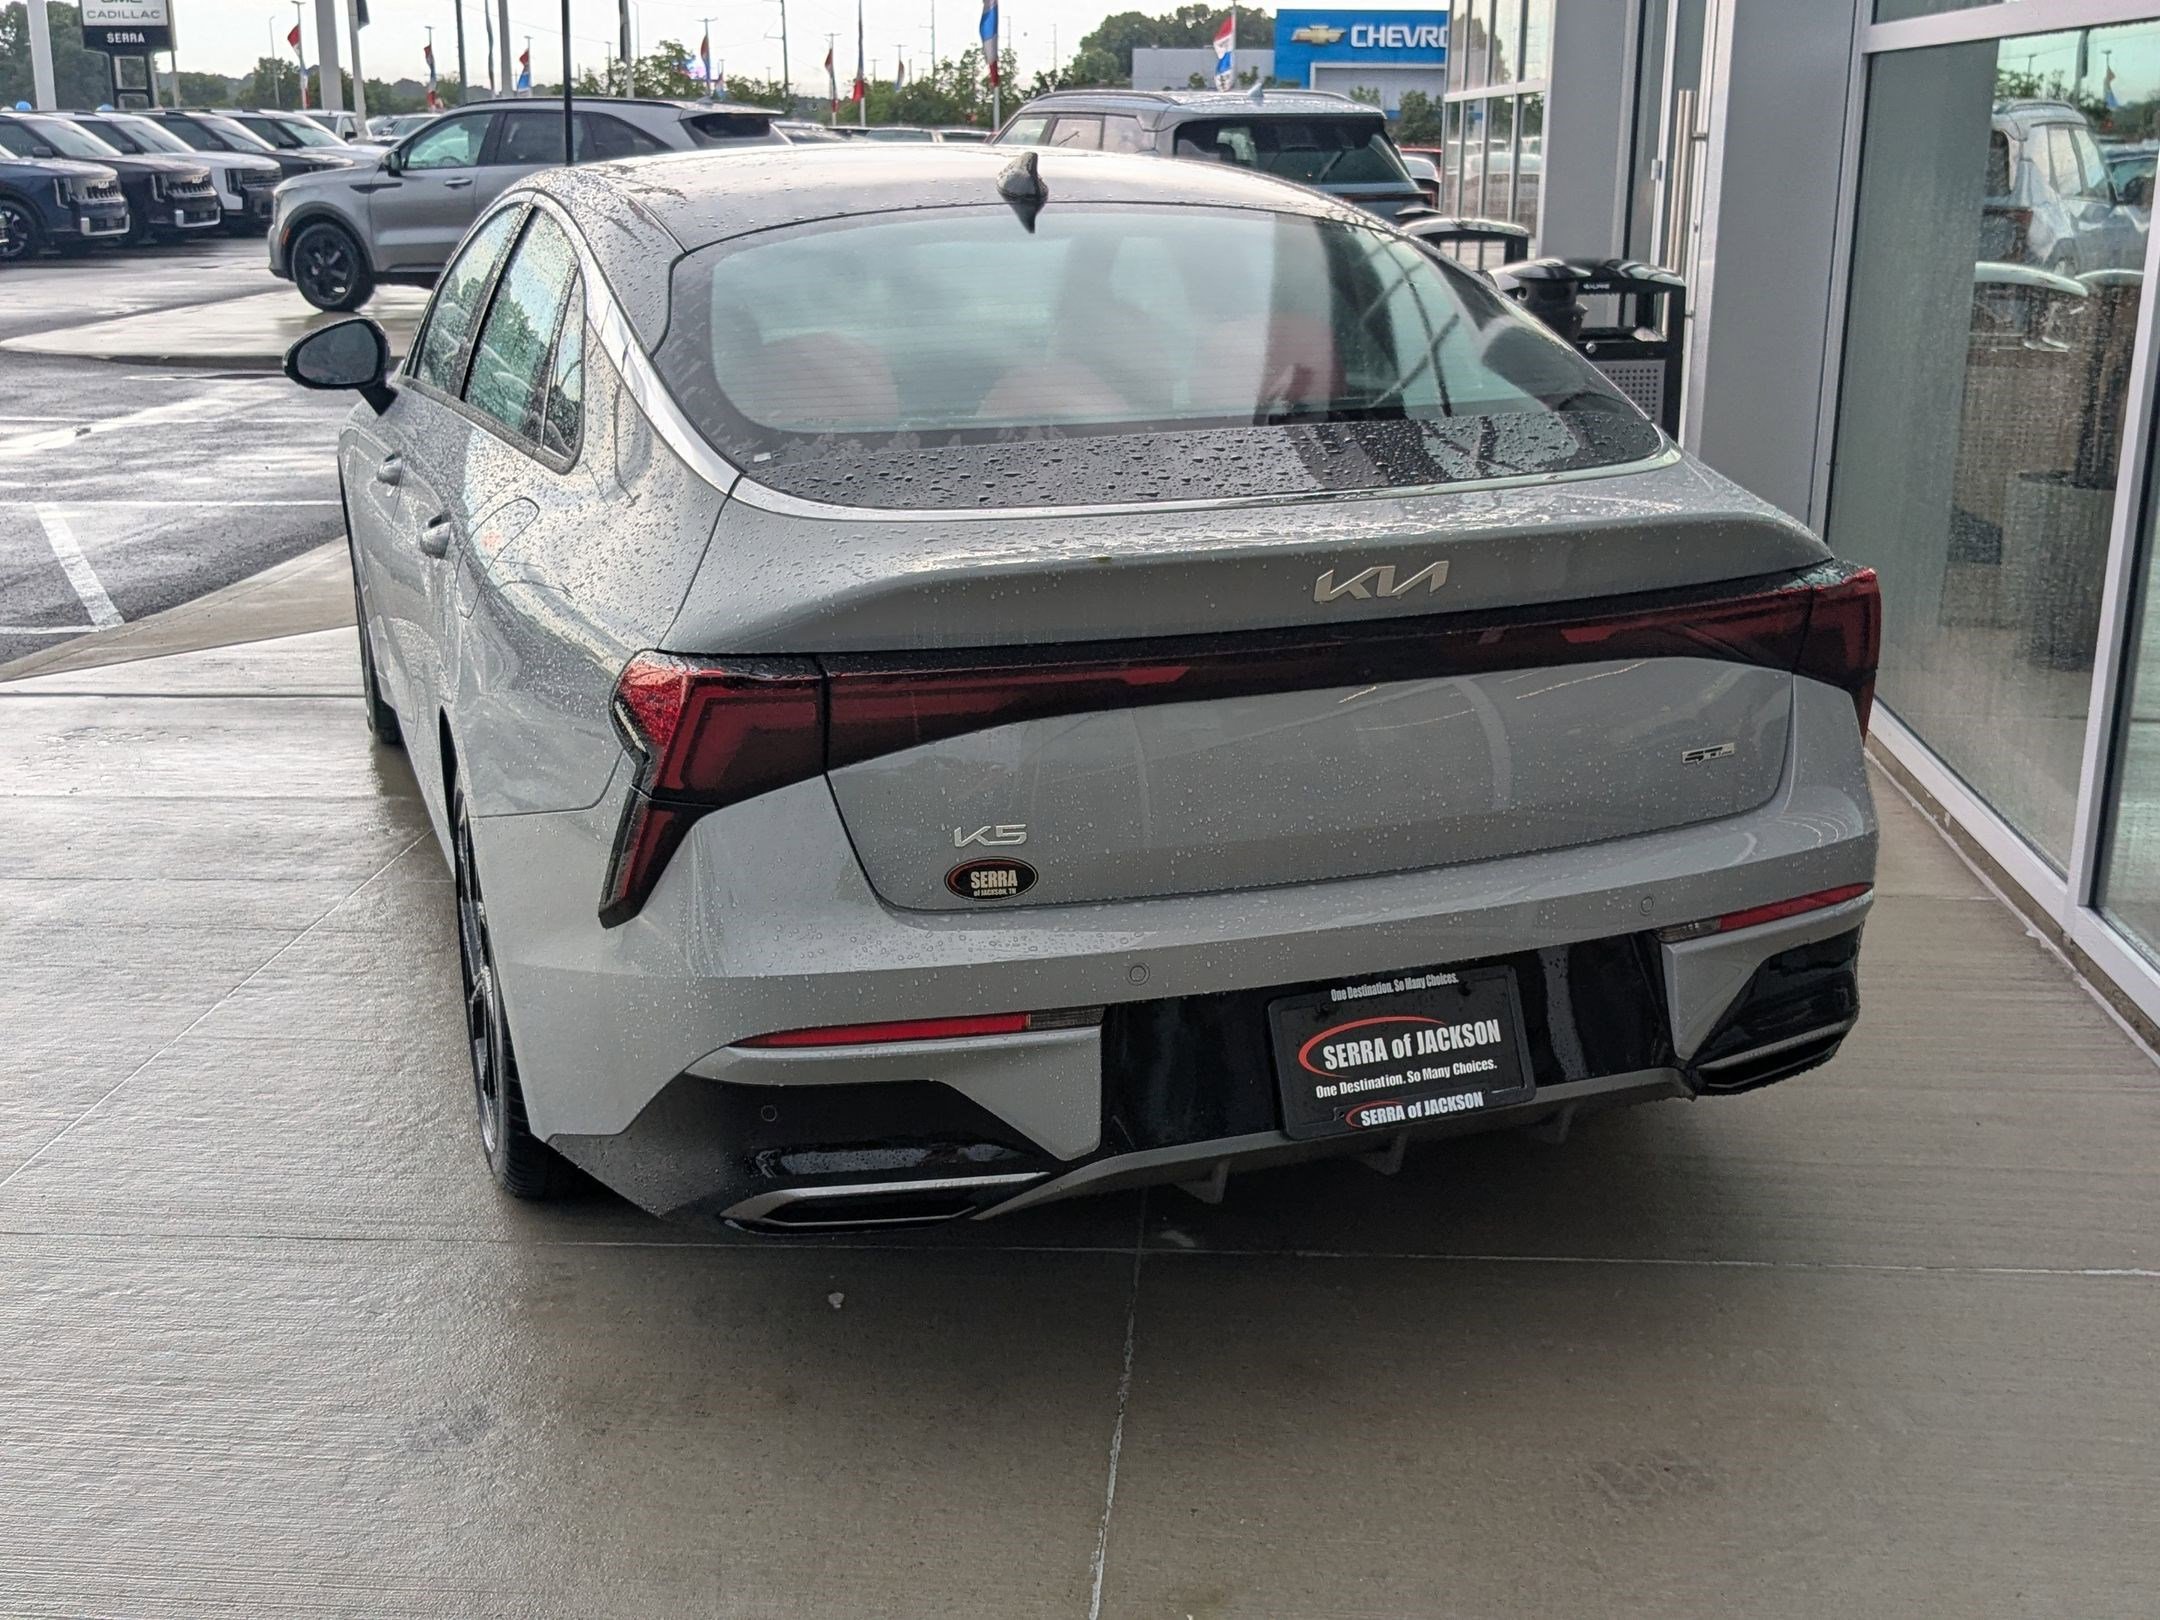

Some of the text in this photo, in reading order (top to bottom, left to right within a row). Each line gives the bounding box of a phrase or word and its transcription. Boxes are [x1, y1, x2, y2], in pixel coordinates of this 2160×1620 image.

[86, 10, 160, 19] CADILLAC
[106, 32, 145, 43] SERRA
[1314, 560, 1449, 602] KIA
[954, 824, 1027, 847] K5
[970, 869, 1018, 889] SERRA
[1331, 972, 1459, 1002] One Destination. So Many Choices.
[1322, 1019, 1502, 1071] SERRA of JACKSON
[1315, 1058, 1498, 1099] One Destination. So Many Choices.
[1360, 1091, 1484, 1127] SERRA of JACKSON
